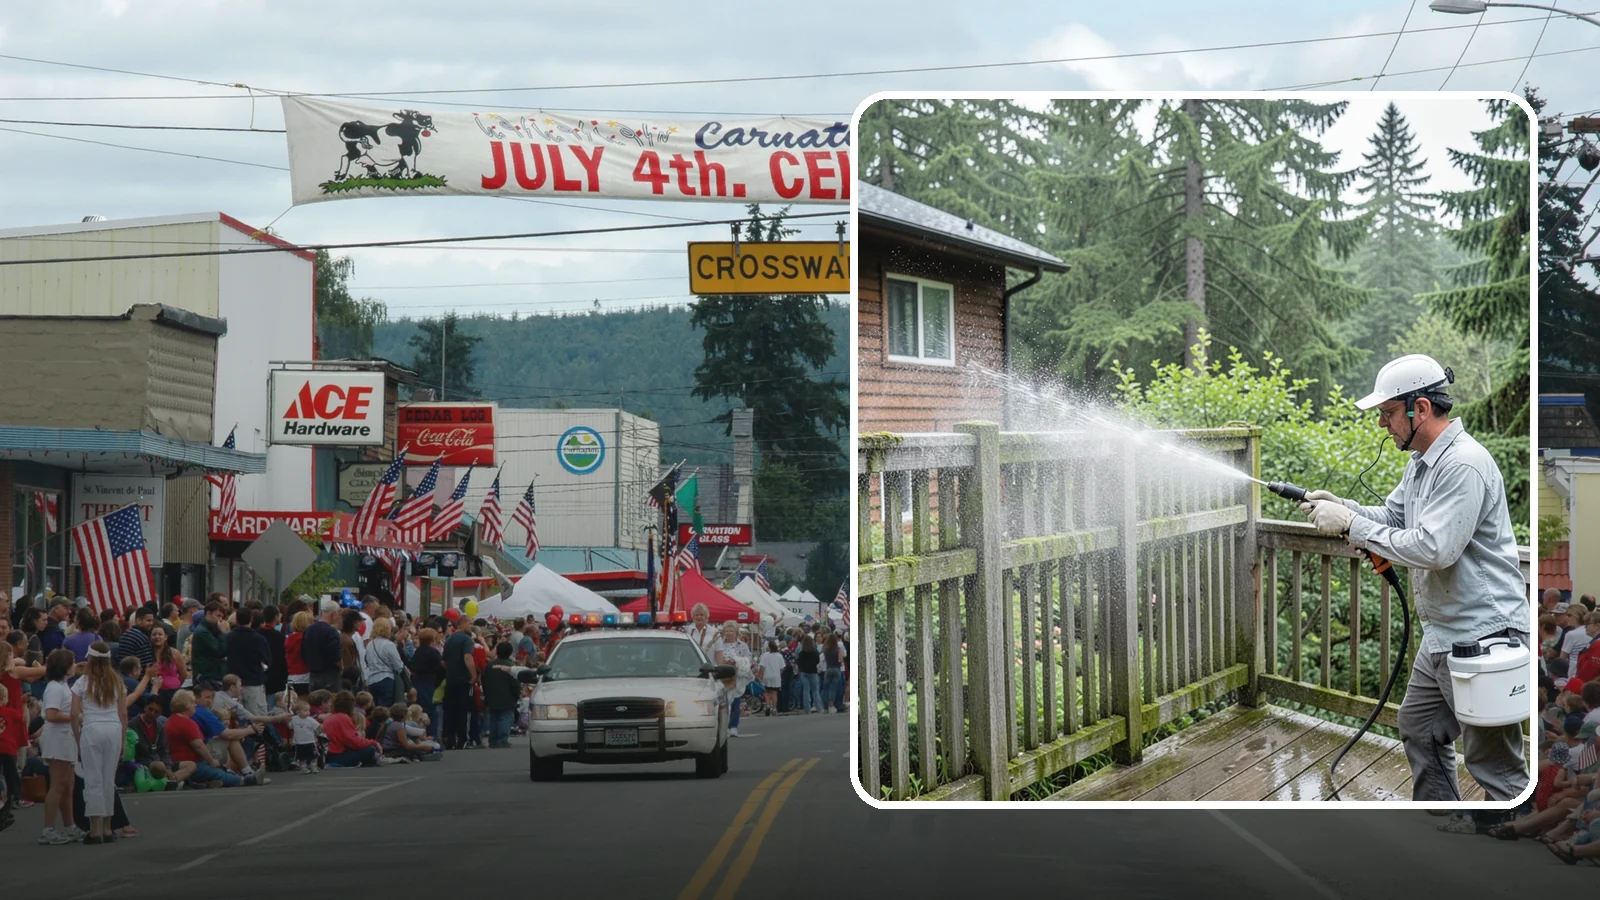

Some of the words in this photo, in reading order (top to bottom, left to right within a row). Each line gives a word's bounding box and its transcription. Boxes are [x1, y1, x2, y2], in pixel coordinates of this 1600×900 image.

[481, 141, 605, 192] JULY
[632, 150, 746, 197] 4th.
[697, 254, 850, 279] CROSSWA
[283, 380, 373, 420] ACE
[406, 409, 453, 422] CEDAR
[461, 409, 485, 421] LOG
[283, 421, 371, 436] Hardware
[416, 428, 477, 447] Coca-Cola
[83, 486, 94, 494] St.
[95, 486, 124, 494] Vincent
[126, 486, 136, 495] de
[138, 486, 155, 495] Paul
[699, 535, 730, 543] GLASS
